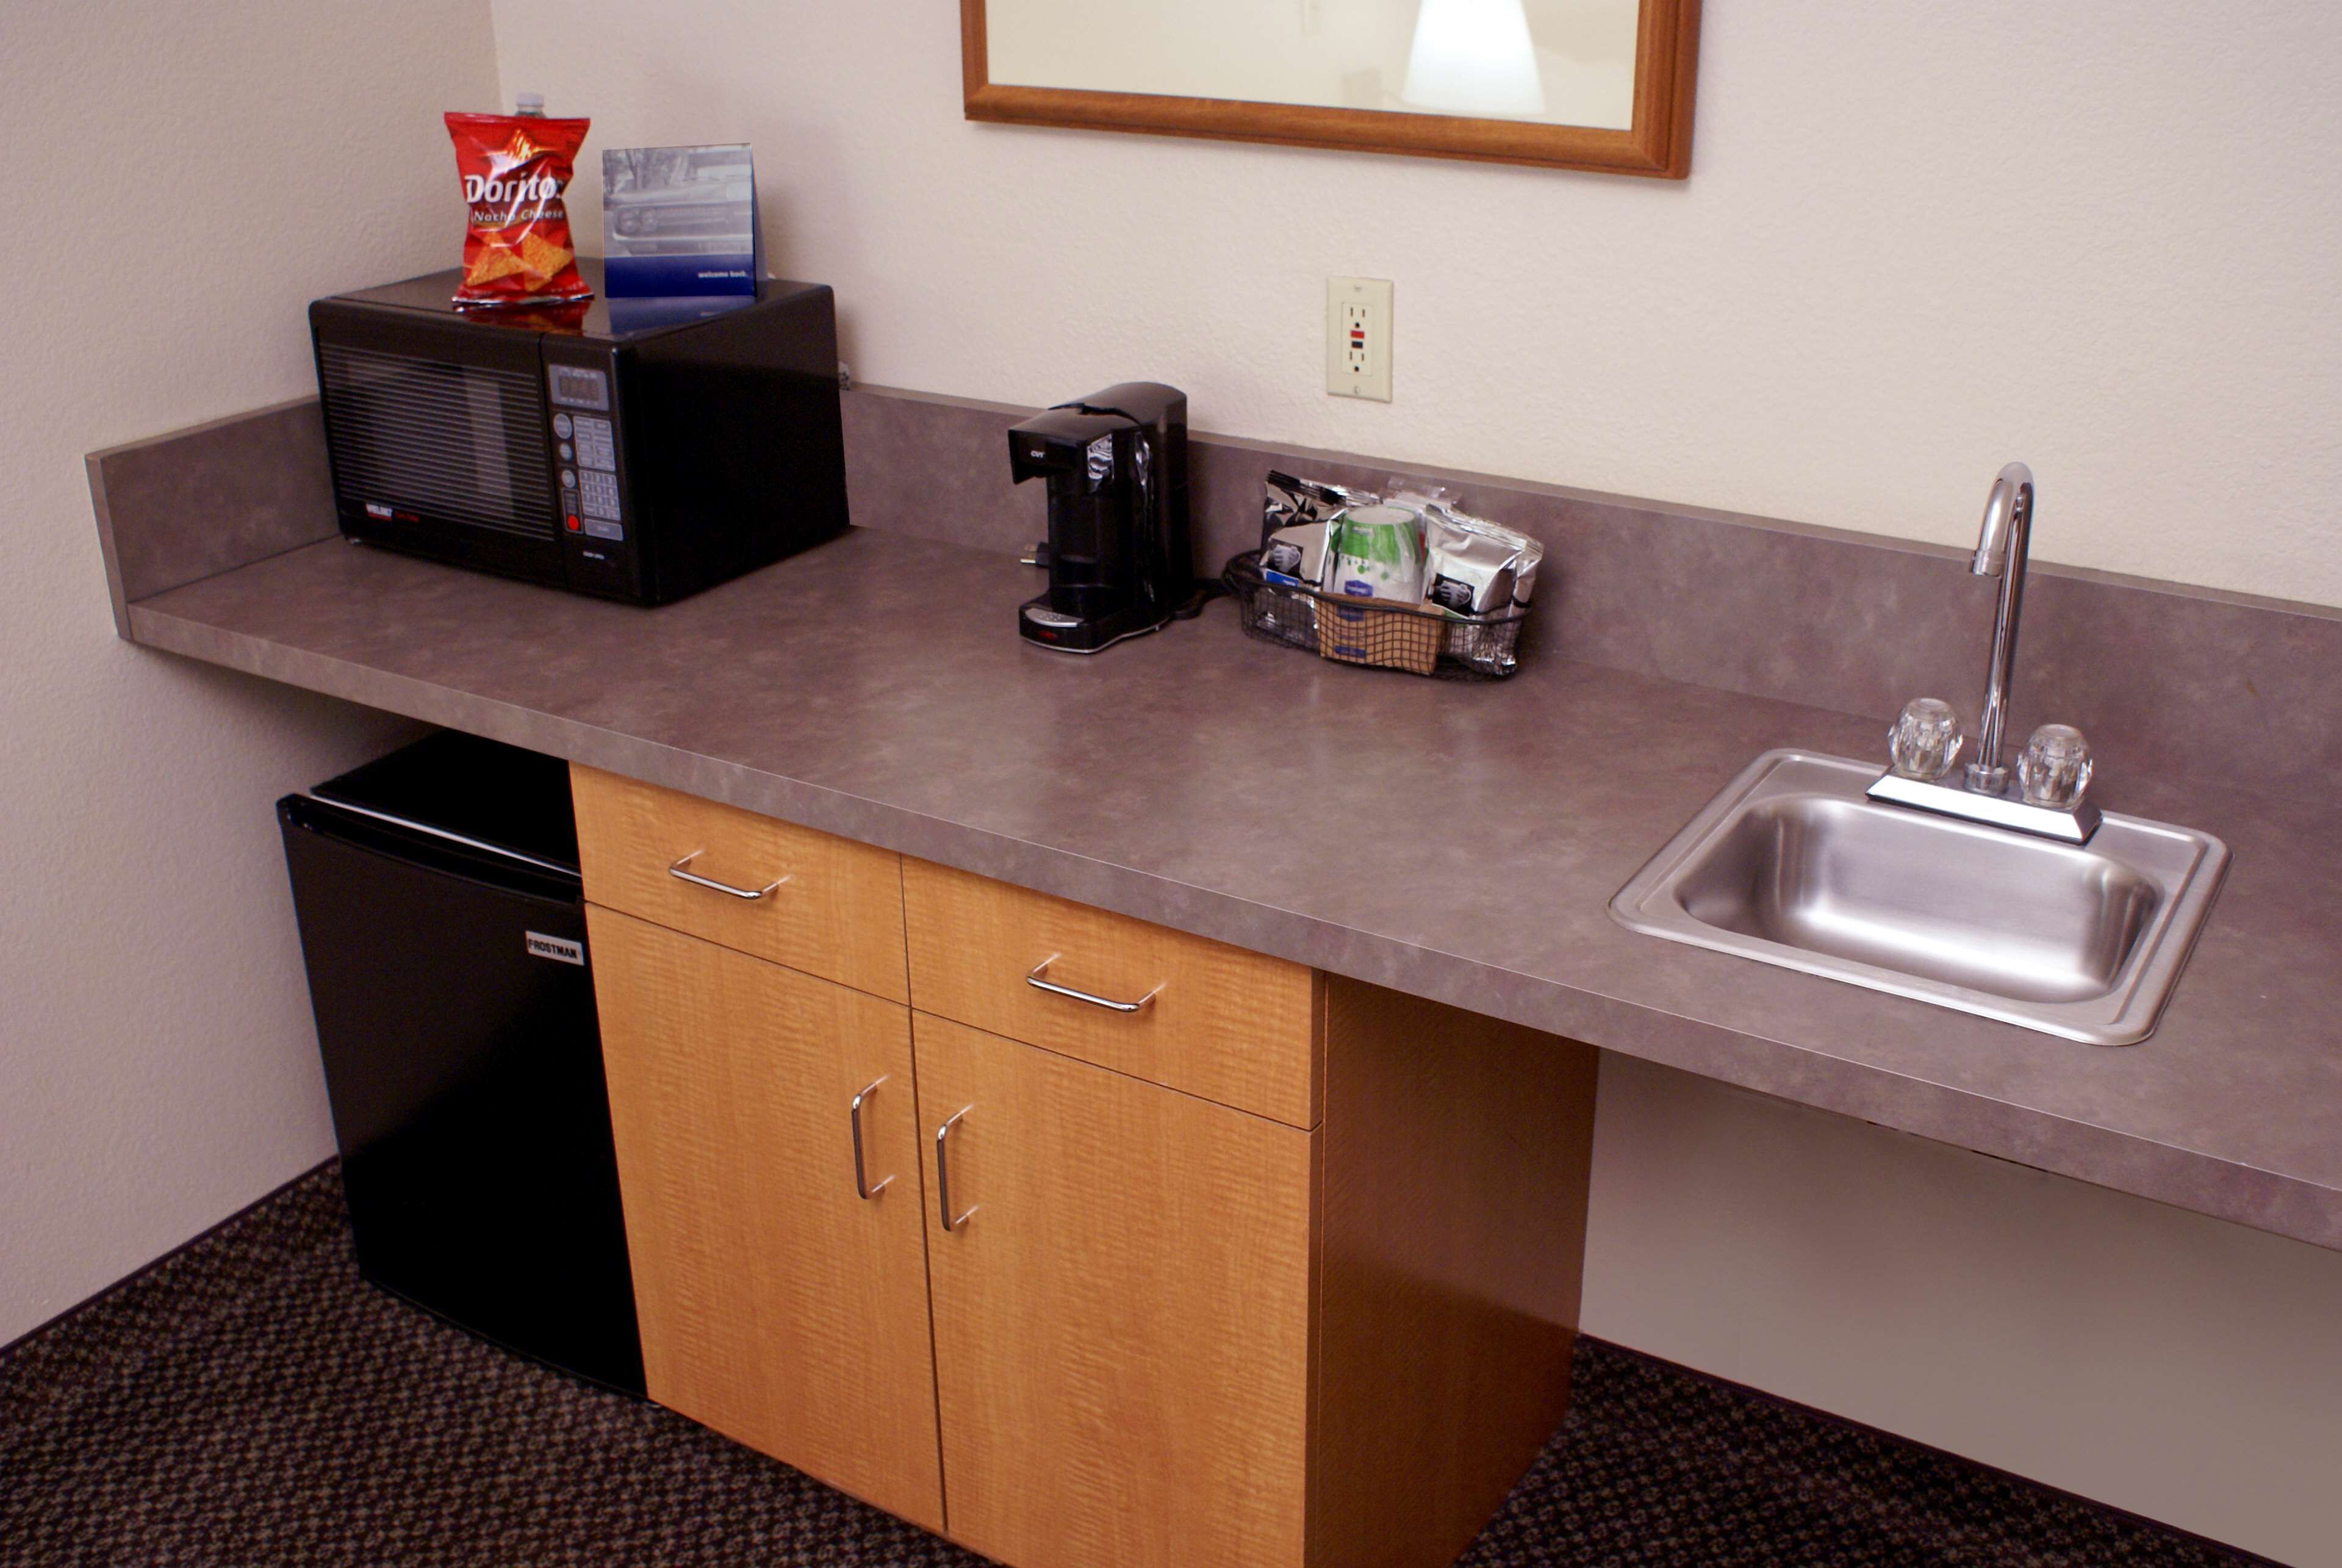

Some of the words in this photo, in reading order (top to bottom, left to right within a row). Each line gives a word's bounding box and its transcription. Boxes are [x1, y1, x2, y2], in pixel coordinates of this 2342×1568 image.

[464, 172, 562, 203] Dorito
[473, 210, 515, 223] Nacho
[520, 209, 564, 220] Cheese
[528, 938, 578, 960] FROSTMAN
